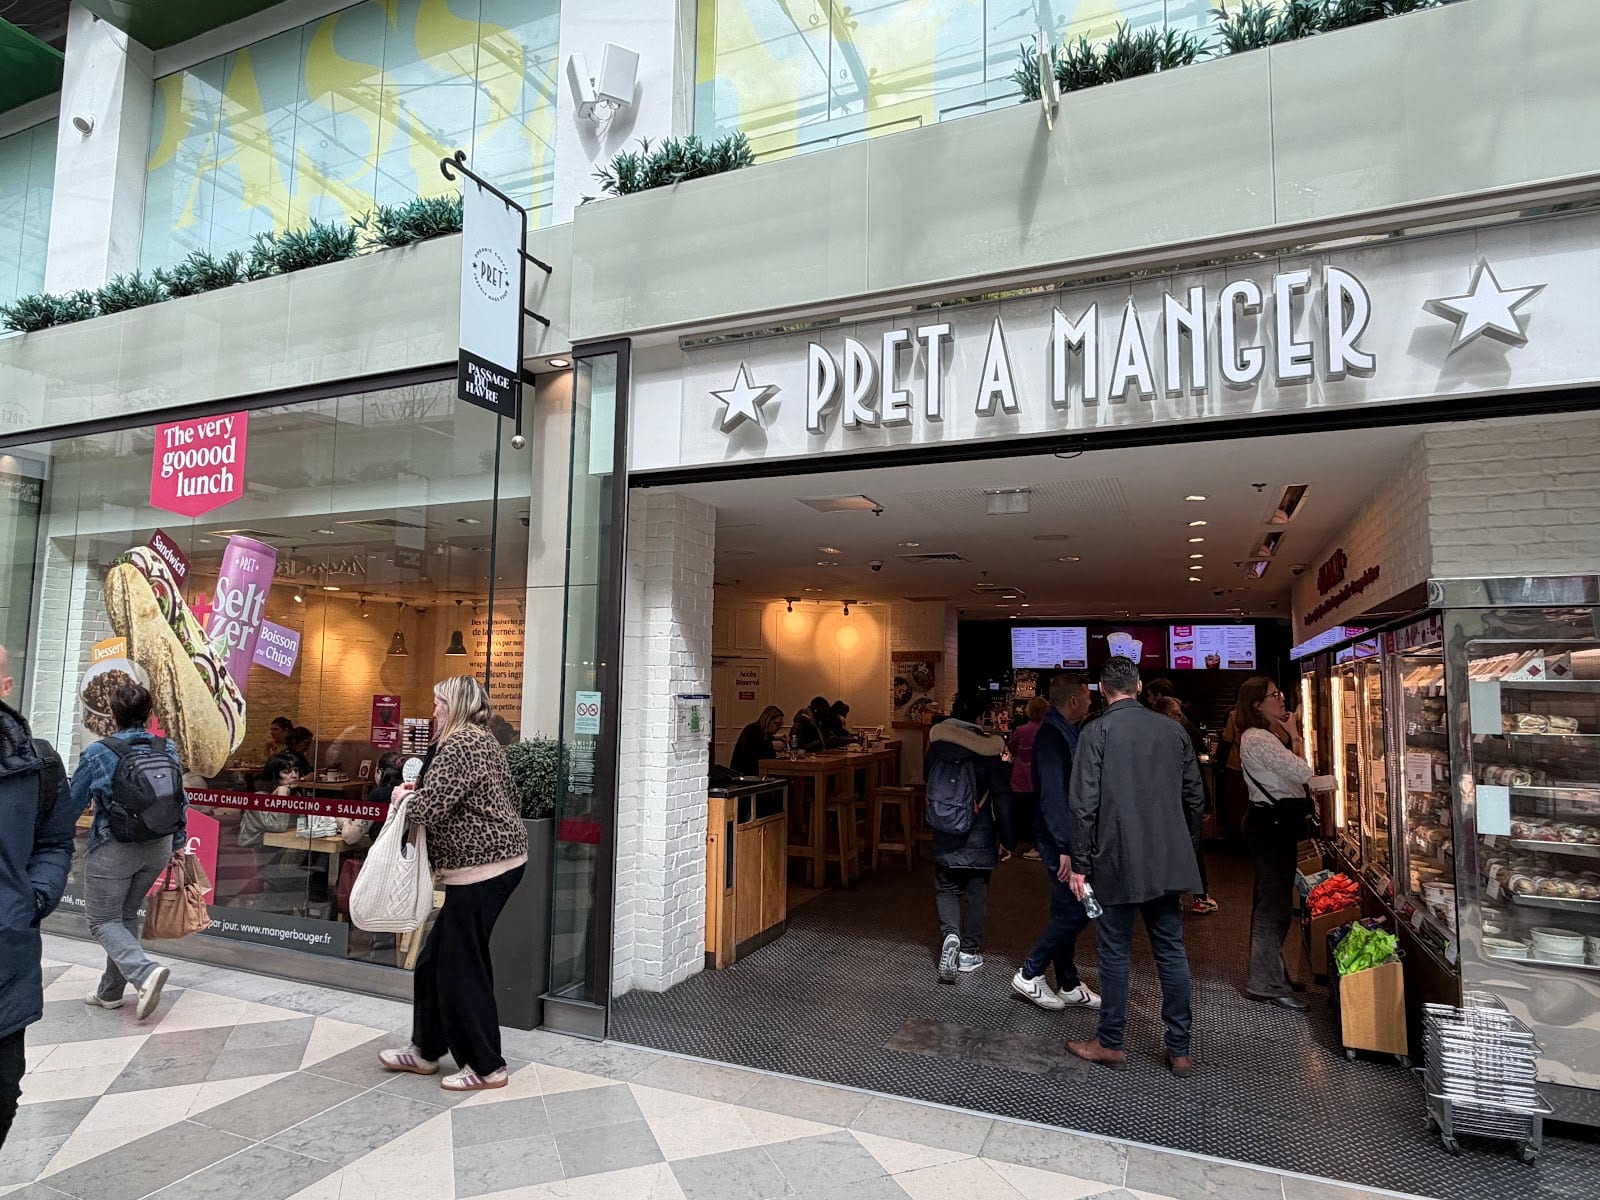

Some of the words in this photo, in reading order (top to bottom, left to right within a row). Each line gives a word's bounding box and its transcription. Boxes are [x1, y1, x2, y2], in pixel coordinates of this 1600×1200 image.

[481, 260, 503, 288] PRET
[806, 321, 955, 435] PRET
[975, 314, 1022, 418] A
[1051, 264, 1377, 410] MANGER
[468, 361, 510, 390] PASSAGE
[474, 374, 489, 391] DU
[465, 380, 499, 404] HAVRE
[163, 426, 194, 449] The
[198, 415, 236, 440] very
[160, 437, 237, 478] gooood
[176, 466, 234, 497] lunch
[152, 535, 187, 578] Sandwich
[239, 556, 257, 573] PRET
[212, 576, 266, 627] Selt
[209, 615, 255, 651] zer
[260, 626, 297, 652] Boisson
[94, 643, 125, 660] Dessert
[265, 646, 293, 667] Chips
[187, 792, 219, 803] OCOLAT
[220, 794, 249, 806] CHAUD
[264, 798, 320, 812] CAPPUCCINO
[337, 804, 381, 817] SALADES
[221, 919, 240, 933] jour.
[240, 922, 332, 945] www.mangerbouger.fr
